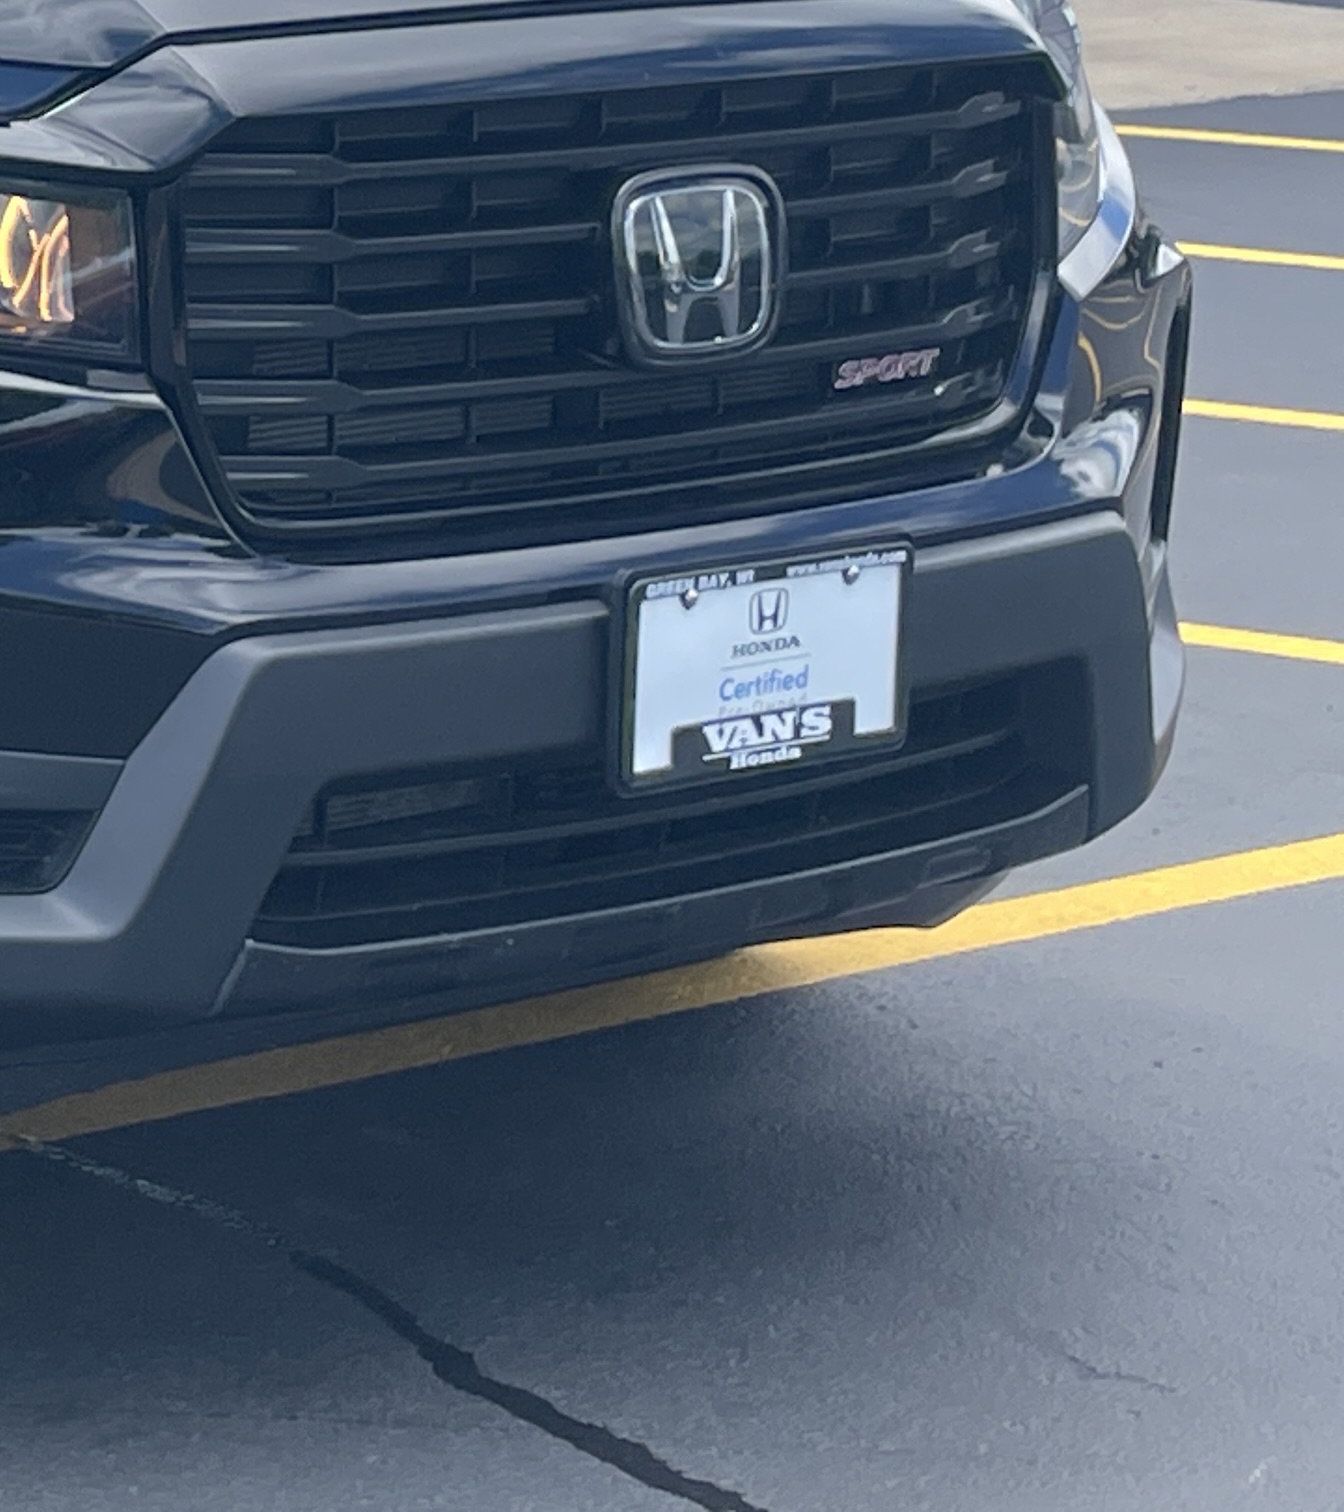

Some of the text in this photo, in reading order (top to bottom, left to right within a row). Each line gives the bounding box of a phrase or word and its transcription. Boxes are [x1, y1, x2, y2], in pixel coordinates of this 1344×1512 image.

[833, 347, 941, 389] SPORT
[730, 636, 801, 659] HONDA
[719, 663, 810, 701] Certified
[729, 745, 803, 769] Honda
